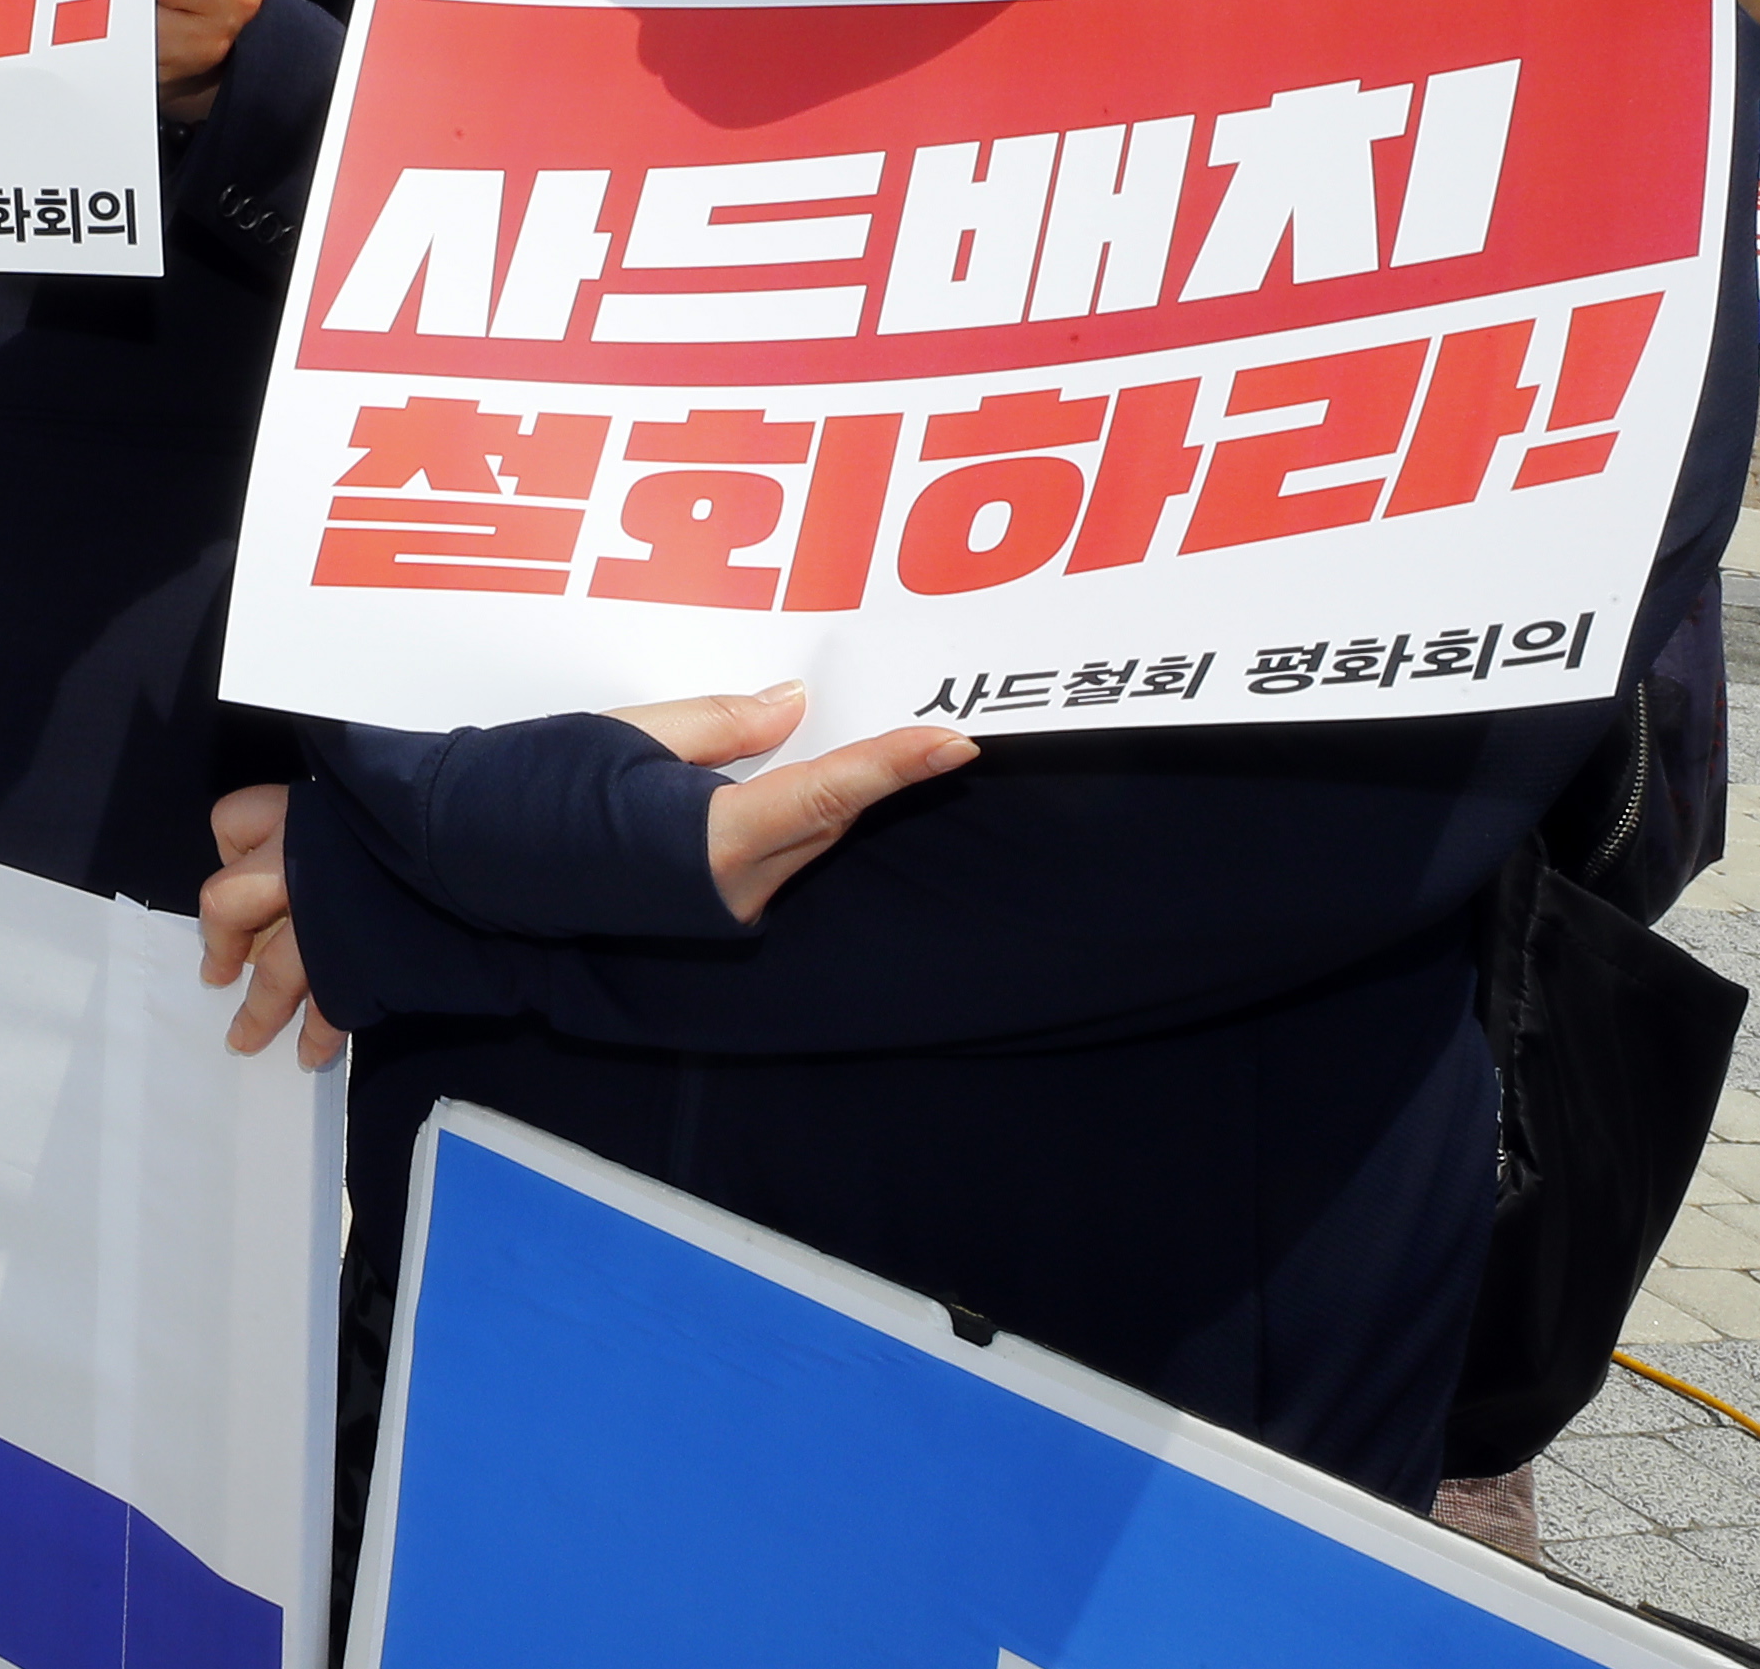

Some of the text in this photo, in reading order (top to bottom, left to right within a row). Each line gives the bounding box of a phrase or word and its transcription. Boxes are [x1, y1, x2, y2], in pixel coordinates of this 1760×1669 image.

[321, 57, 1522, 345] 사드배치
[309, 290, 1665, 612] 철회하라!
[914, 611, 1596, 722] 사드철회 평화회의
